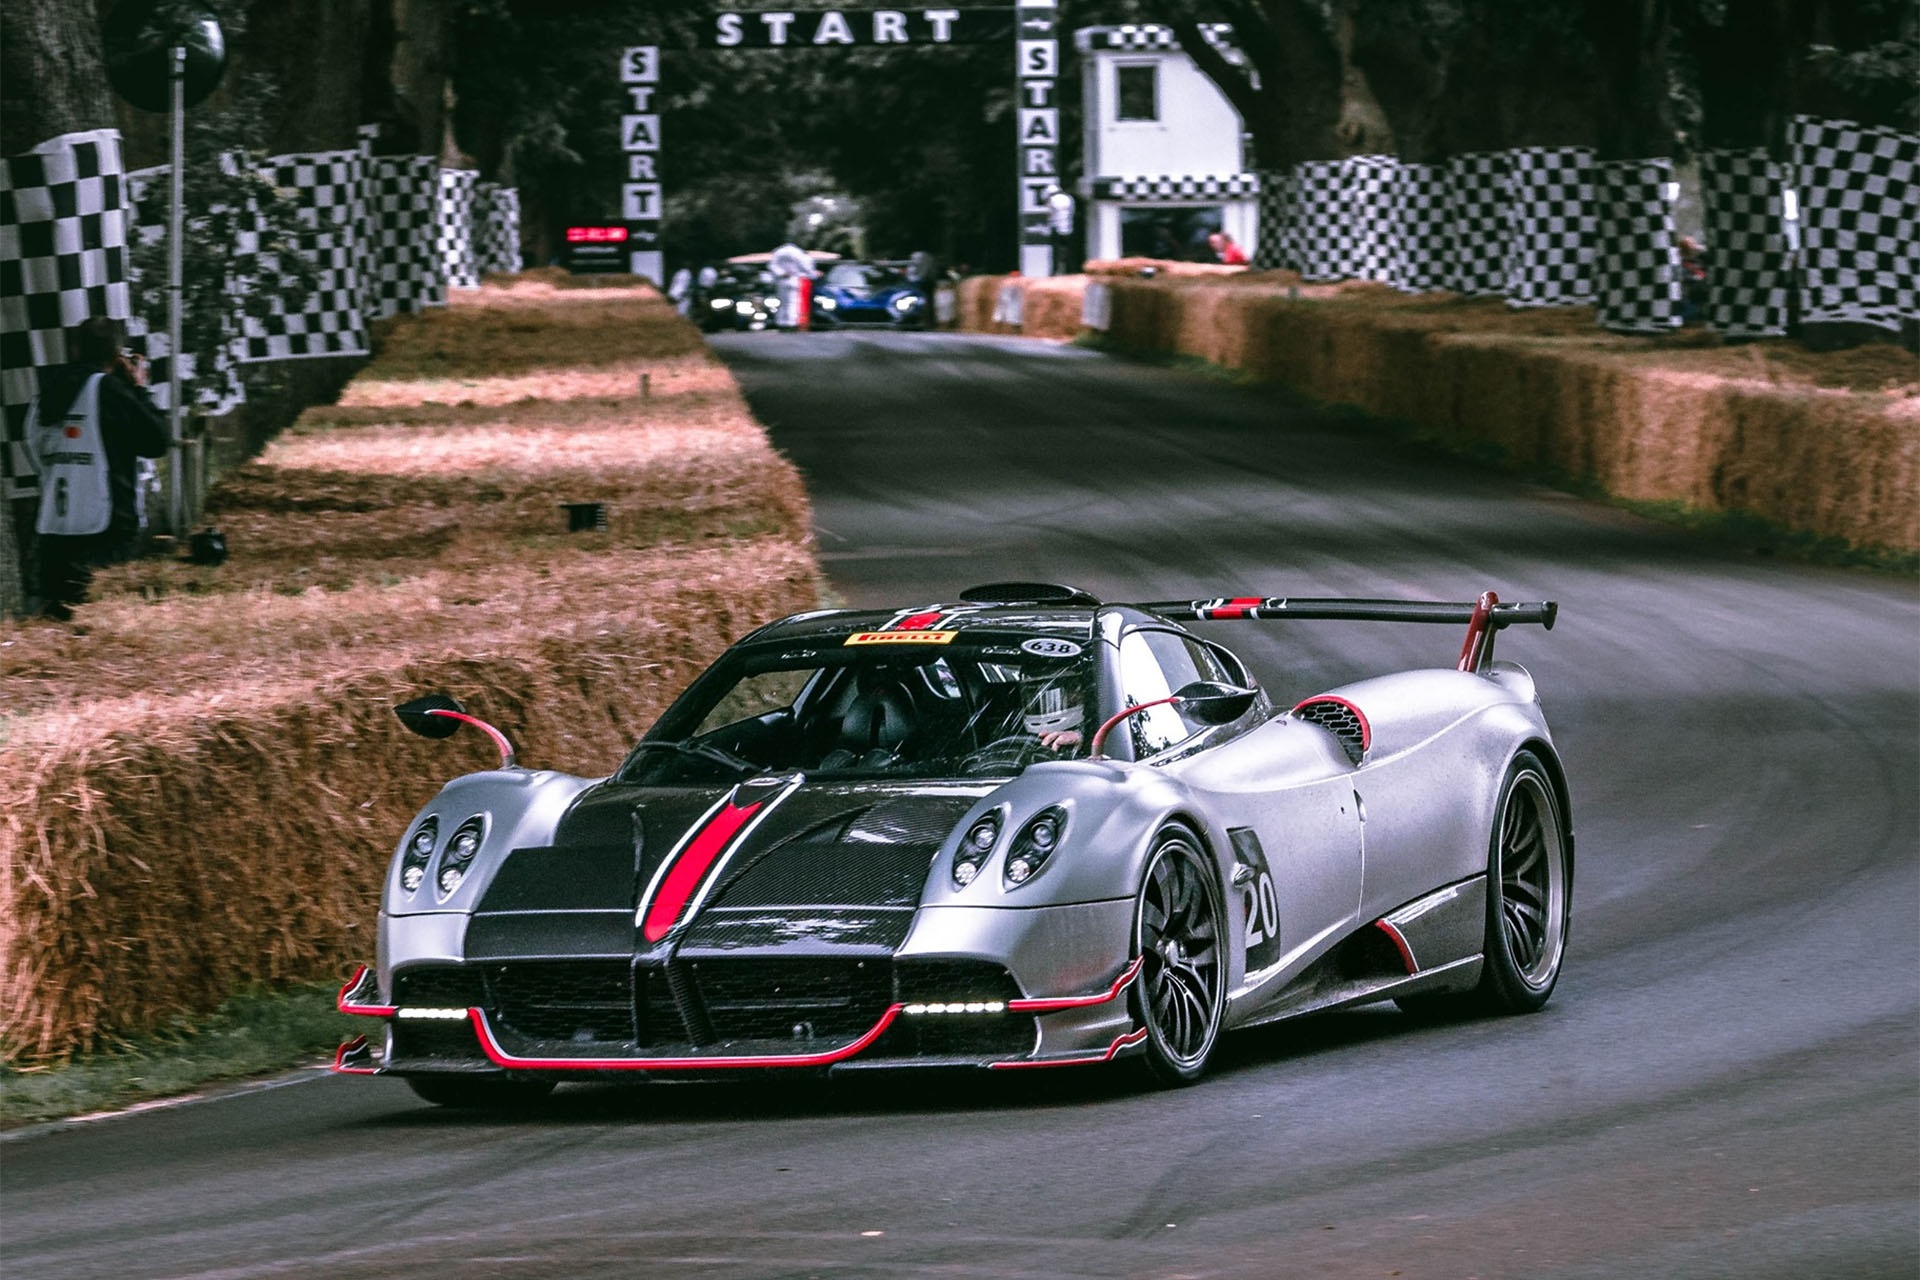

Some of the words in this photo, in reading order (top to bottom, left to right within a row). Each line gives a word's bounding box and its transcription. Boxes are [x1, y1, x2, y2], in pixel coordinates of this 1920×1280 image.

[716, 9, 960, 46] START
[627, 51, 657, 213] START
[1023, 47, 1055, 207] START
[857, 632, 945, 642] PIRELLI
[1031, 641, 1072, 654] 638
[1244, 872, 1278, 949] 20
